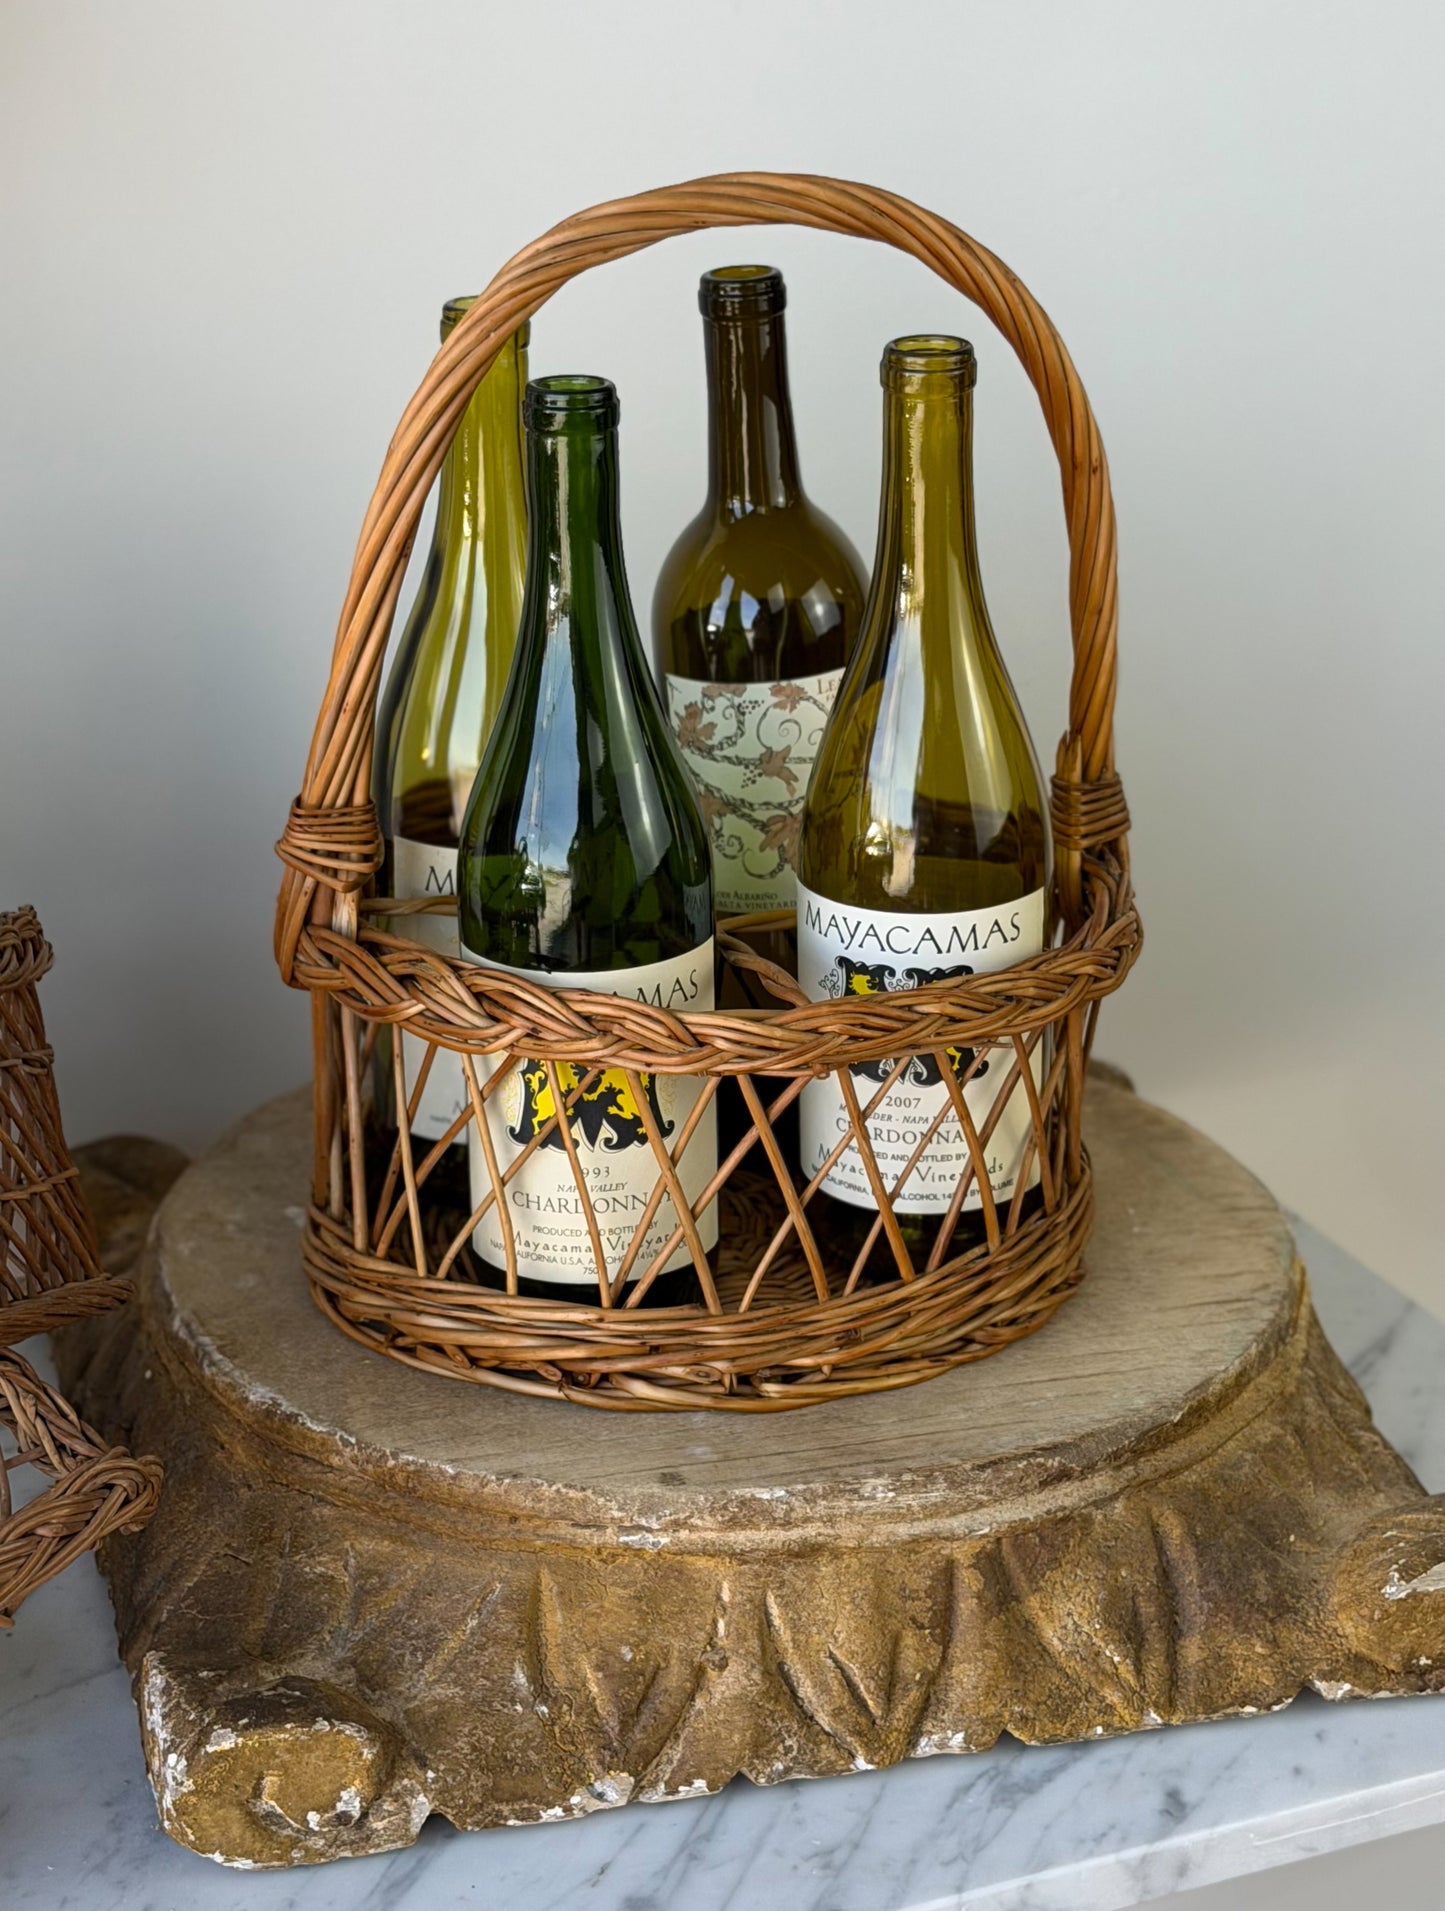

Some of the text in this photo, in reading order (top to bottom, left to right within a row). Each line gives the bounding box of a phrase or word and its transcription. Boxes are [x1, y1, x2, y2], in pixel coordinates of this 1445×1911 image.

[804, 901, 1021, 955] MAYACAMAS
[885, 1095, 921, 1109] 2007
[902, 1115, 929, 1125] NAPA
[890, 1153, 909, 1163] AND
[918, 1154, 953, 1163] OTTLED
[955, 1152, 967, 1160] BY
[581, 1166, 610, 1179] 993
[590, 1182, 627, 1193] VALLEY
[532, 1225, 582, 1237] PRODUCED
[516, 1250, 558, 1264] ALIFORNIA
